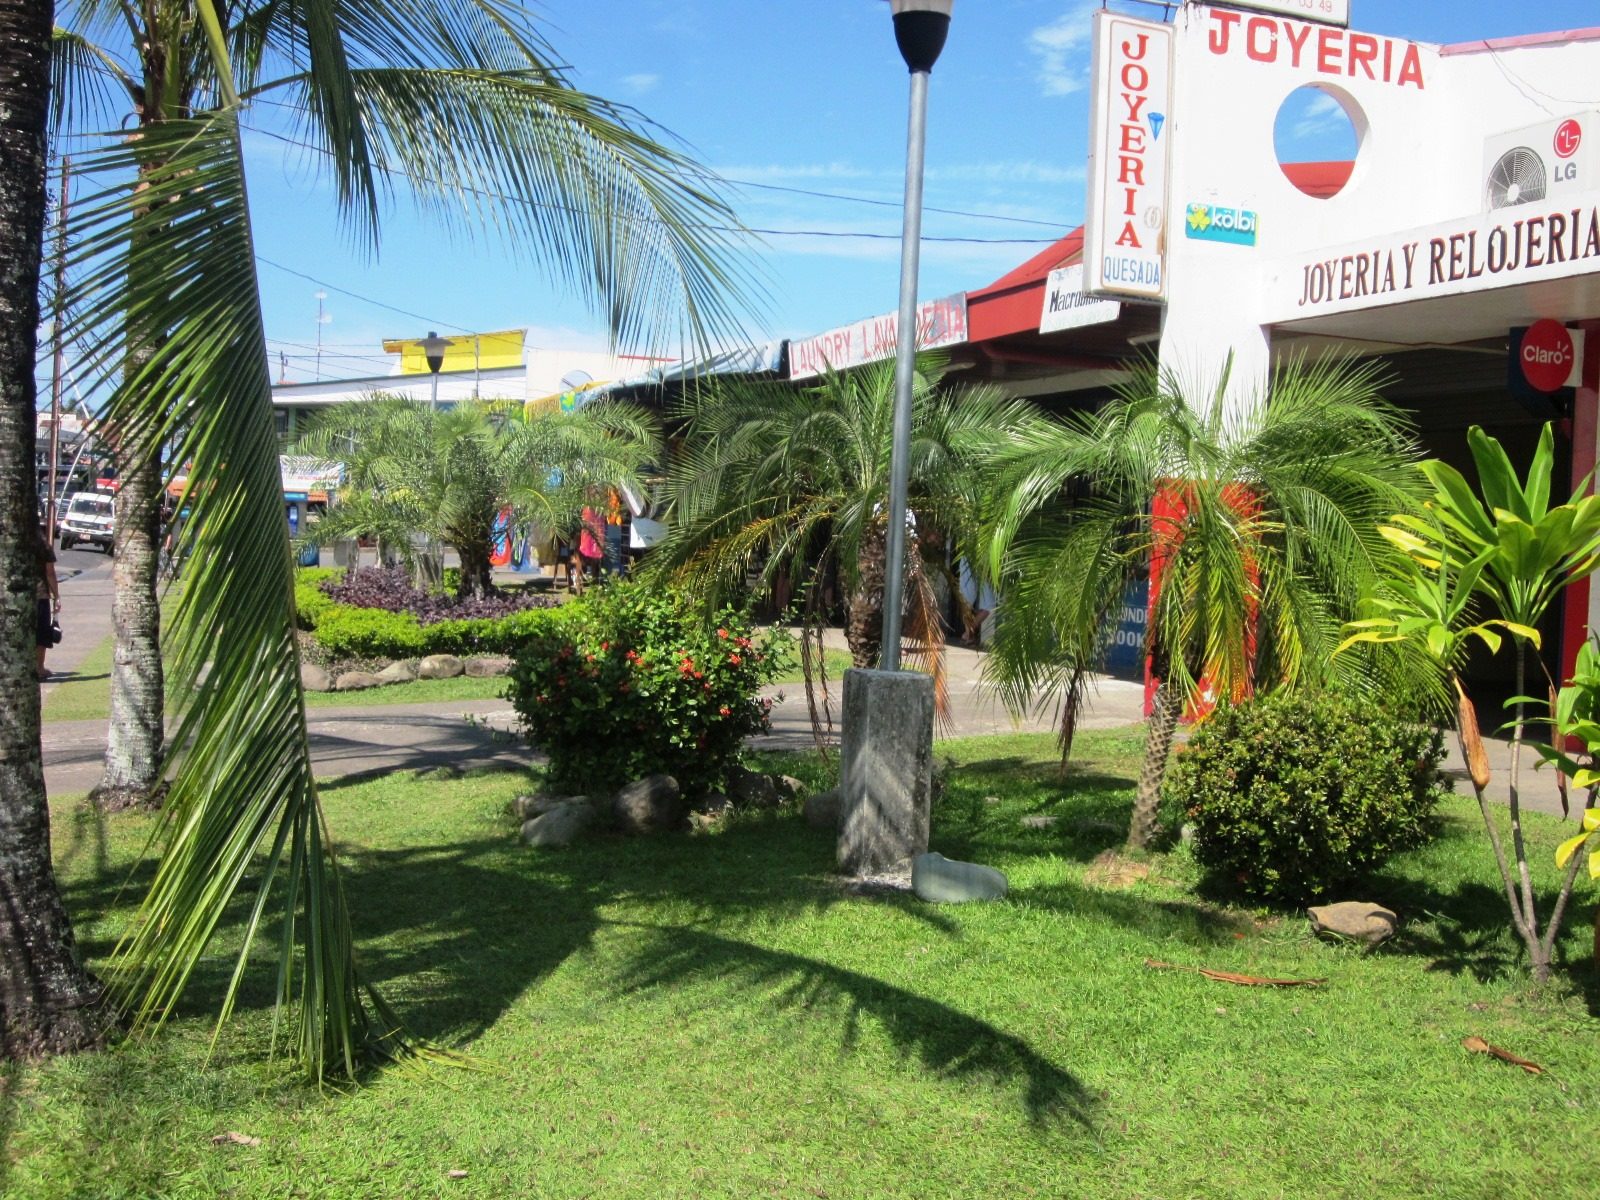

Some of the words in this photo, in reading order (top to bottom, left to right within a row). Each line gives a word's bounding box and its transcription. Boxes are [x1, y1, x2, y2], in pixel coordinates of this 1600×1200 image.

[1208, 9, 1425, 90] JOYERIA
[1116, 33, 1150, 248] JOYERIA
[1554, 162, 1577, 182] LG
[1103, 256, 1160, 286] QUESADA
[1298, 248, 1396, 306] JOYERIA
[1402, 242, 1418, 290] Y
[1428, 206, 1600, 285] RELOJERIA
[790, 330, 851, 376] LAUNDRY
[862, 303, 965, 359] LAVAERIA
[1523, 344, 1564, 365] Claro
